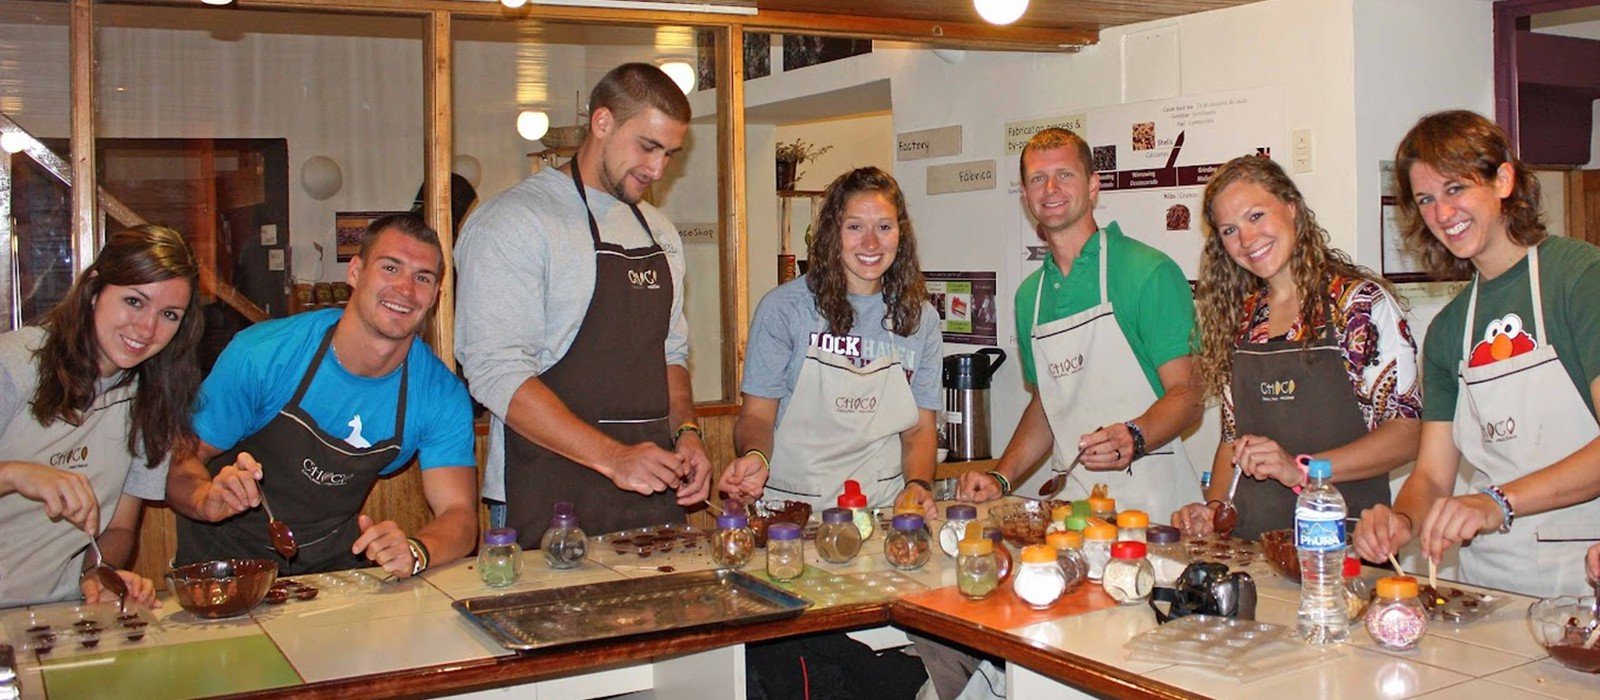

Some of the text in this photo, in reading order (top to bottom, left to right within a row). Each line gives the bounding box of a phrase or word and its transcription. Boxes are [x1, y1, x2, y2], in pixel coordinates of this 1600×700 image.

[1008, 124, 1045, 137] Fabrication
[1075, 118, 1081, 129] &
[898, 141, 930, 153] Factory
[958, 169, 992, 183] Fábrica
[678, 227, 714, 239] ocoShop
[810, 331, 862, 357] LOCK
[1048, 353, 1084, 375] CHOCO
[1260, 379, 1296, 396] CHOCO
[834, 396, 877, 410] CHOCO
[50, 446, 88, 467] CHOCO
[1300, 533, 1341, 547] PhURA
